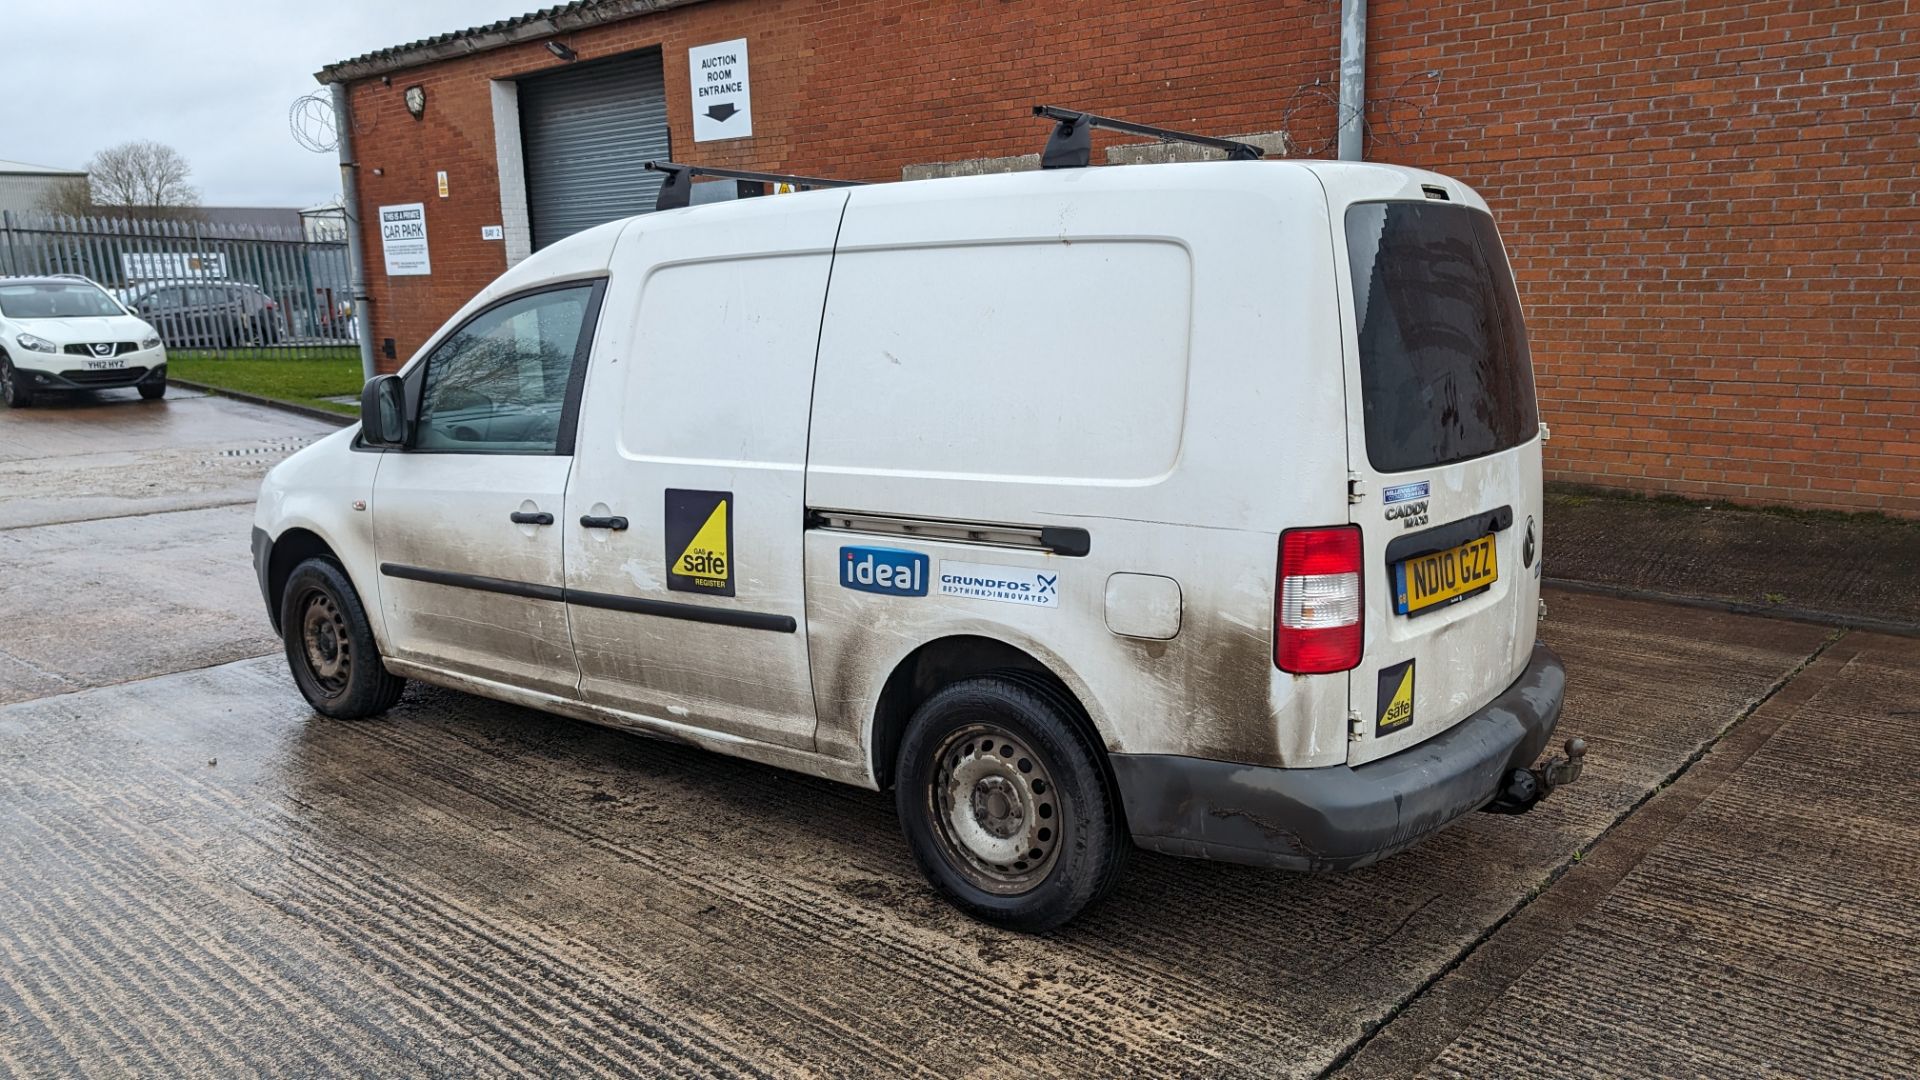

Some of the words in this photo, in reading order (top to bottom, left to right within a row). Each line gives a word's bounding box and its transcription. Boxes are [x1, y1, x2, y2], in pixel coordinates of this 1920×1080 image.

[702, 54, 737, 69] AUCTION
[707, 69, 732, 82] ROOM
[698, 81, 743, 97] ENTRANCE
[383, 225, 401, 239] CAR
[402, 223, 424, 237] PARK
[496, 228, 500, 237] 2
[88, 361, 107, 369] YH12
[108, 360, 125, 368] HYZ
[1384, 500, 1429, 521] CADDY
[693, 547, 706, 555] GAS
[683, 551, 725, 575] safe
[1413, 552, 1456, 600] ND10
[1459, 541, 1491, 584] GZZ
[847, 552, 921, 591] ideal
[695, 578, 726, 588] REGISTER
[941, 574, 1031, 592] GRUNDFOS
[1387, 700, 1410, 721] safe
